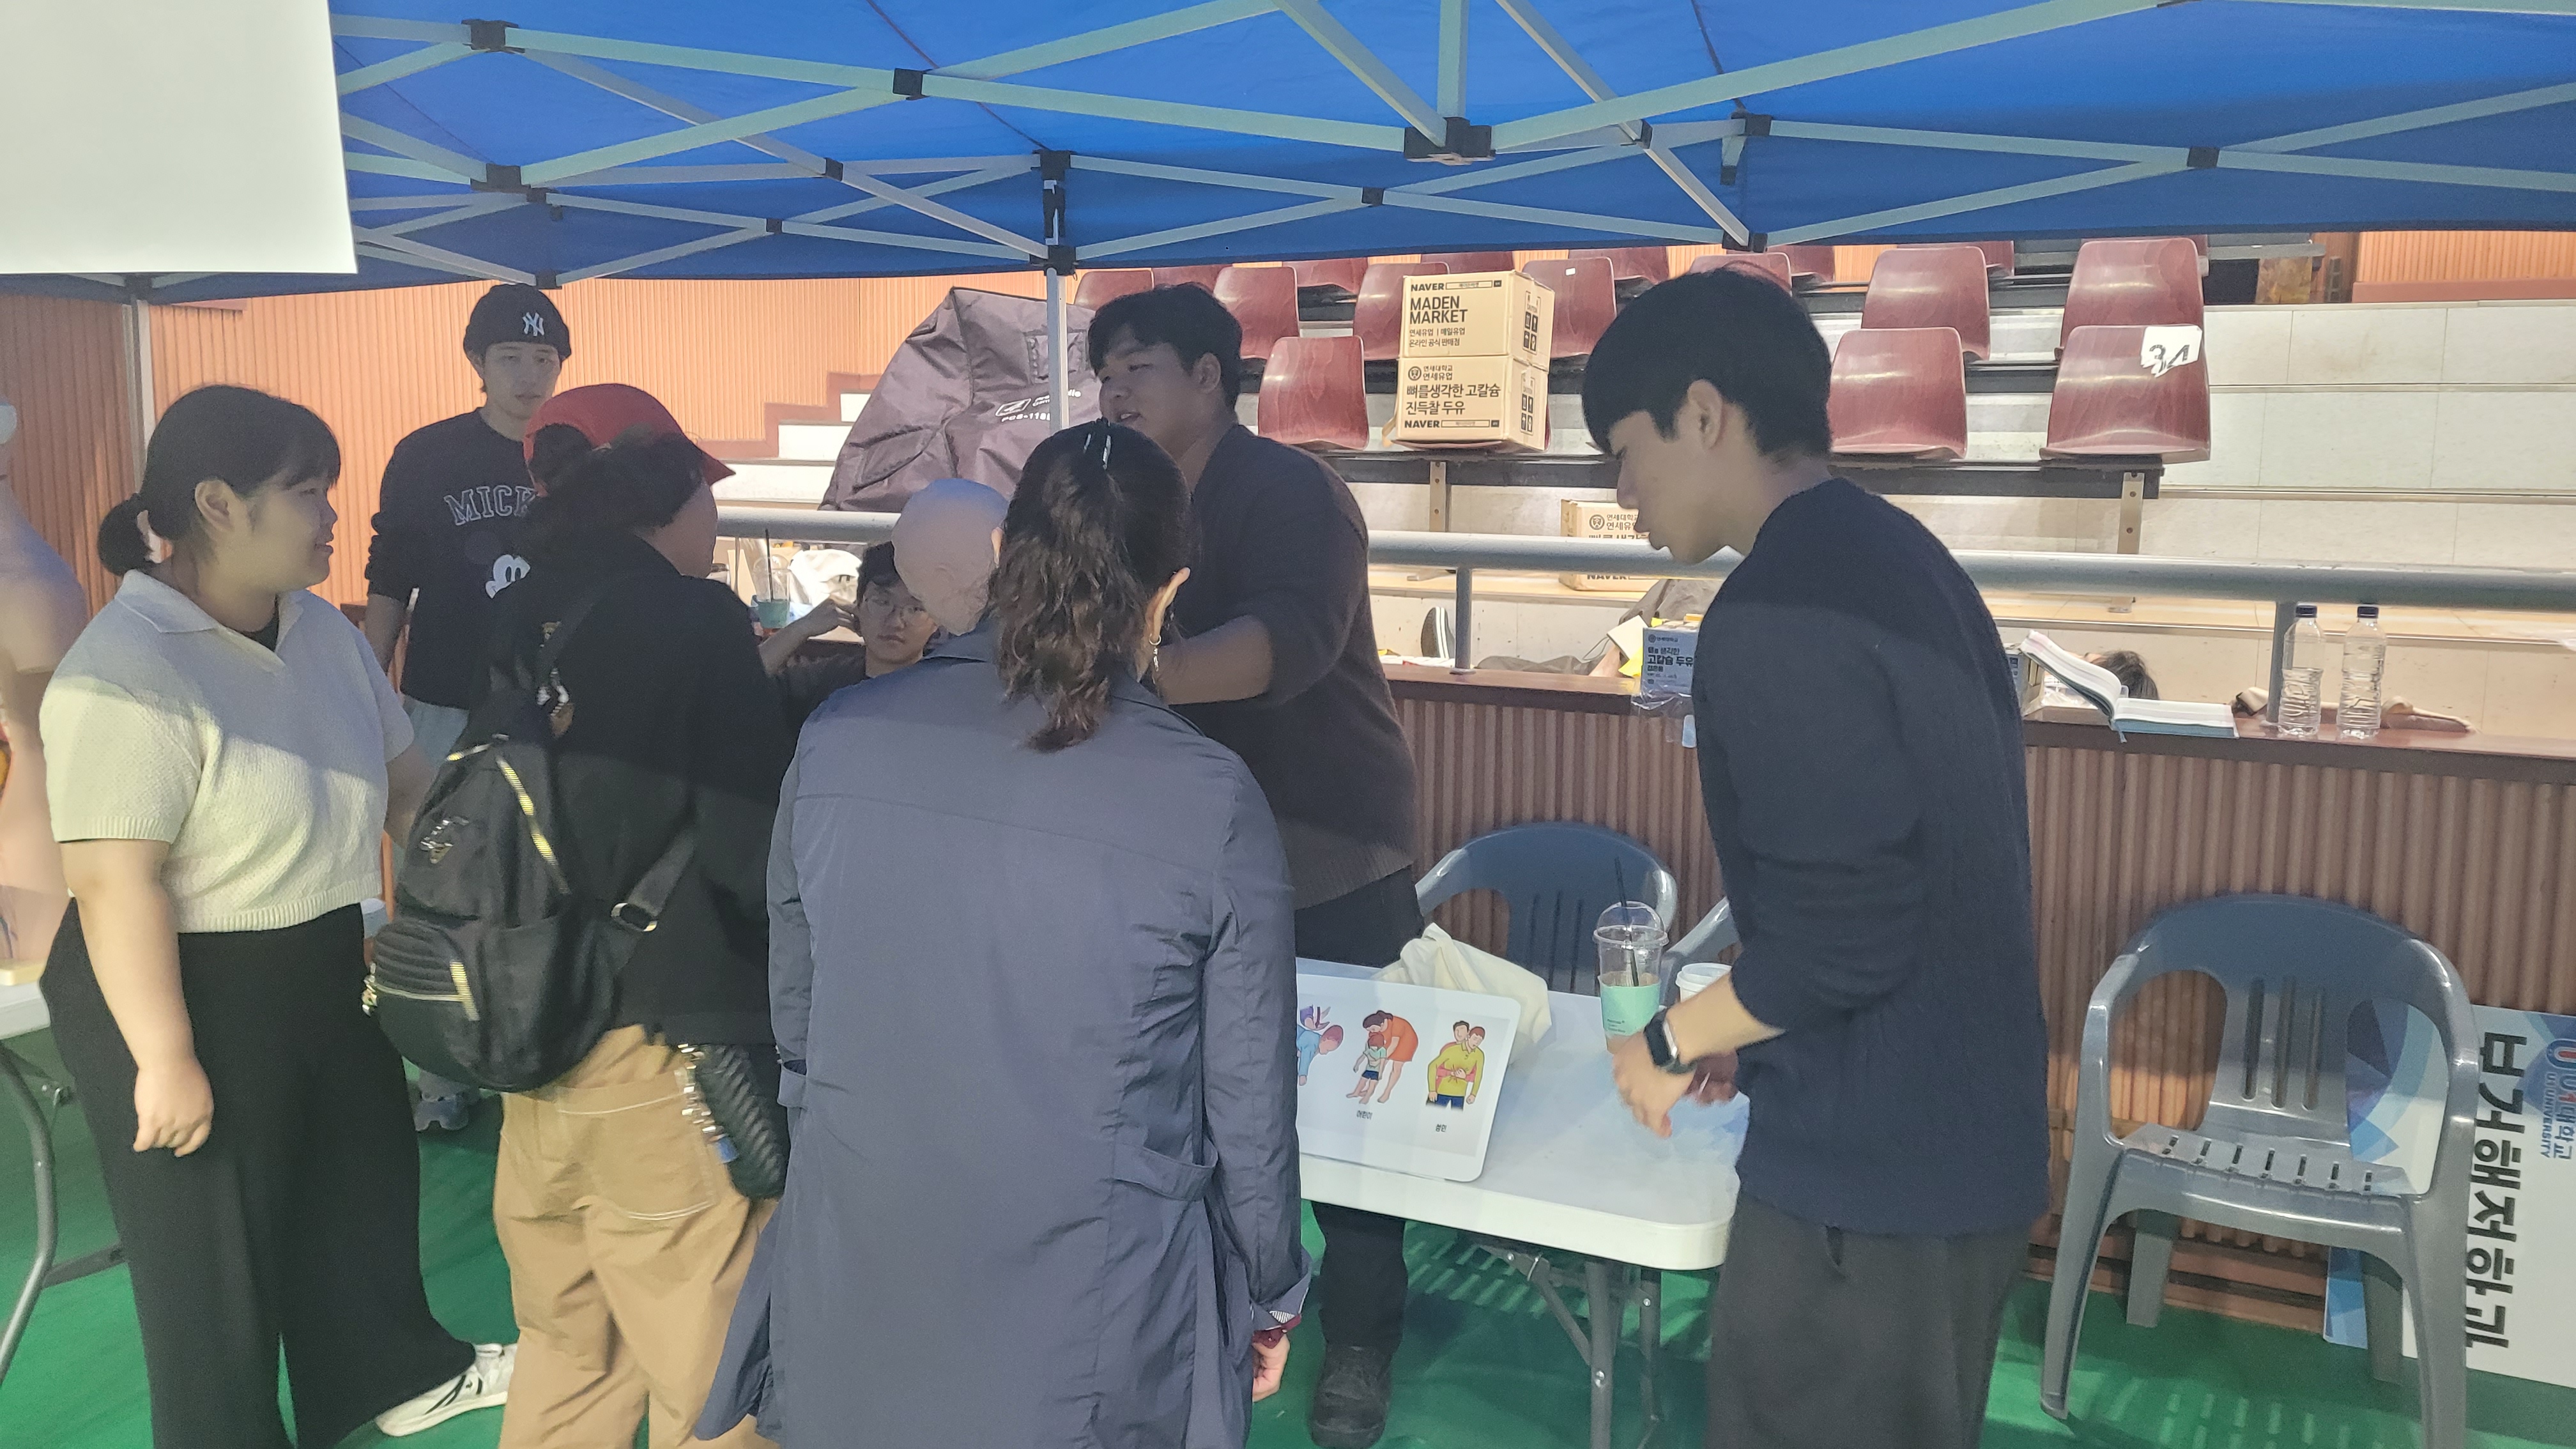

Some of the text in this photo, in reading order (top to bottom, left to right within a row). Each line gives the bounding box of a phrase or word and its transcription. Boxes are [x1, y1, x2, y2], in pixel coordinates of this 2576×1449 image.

[1411, 283, 1445, 291] NAVER
[1410, 295, 1460, 310] MADEN
[522, 312, 544, 336] NY
[1409, 309, 1468, 325] MARKET
[1409, 327, 1466, 337] 연세유업 매일유업
[1409, 337, 1460, 348] 온라인 공식 판매점
[1423, 372, 1453, 381] 연세유업
[1465, 383, 1501, 397] 고칼슘
[1406, 401, 1466, 415] 진득찰 두유
[1404, 420, 1440, 428] NAVER
[2540, 1088, 2556, 1158] UNIVERSITY
